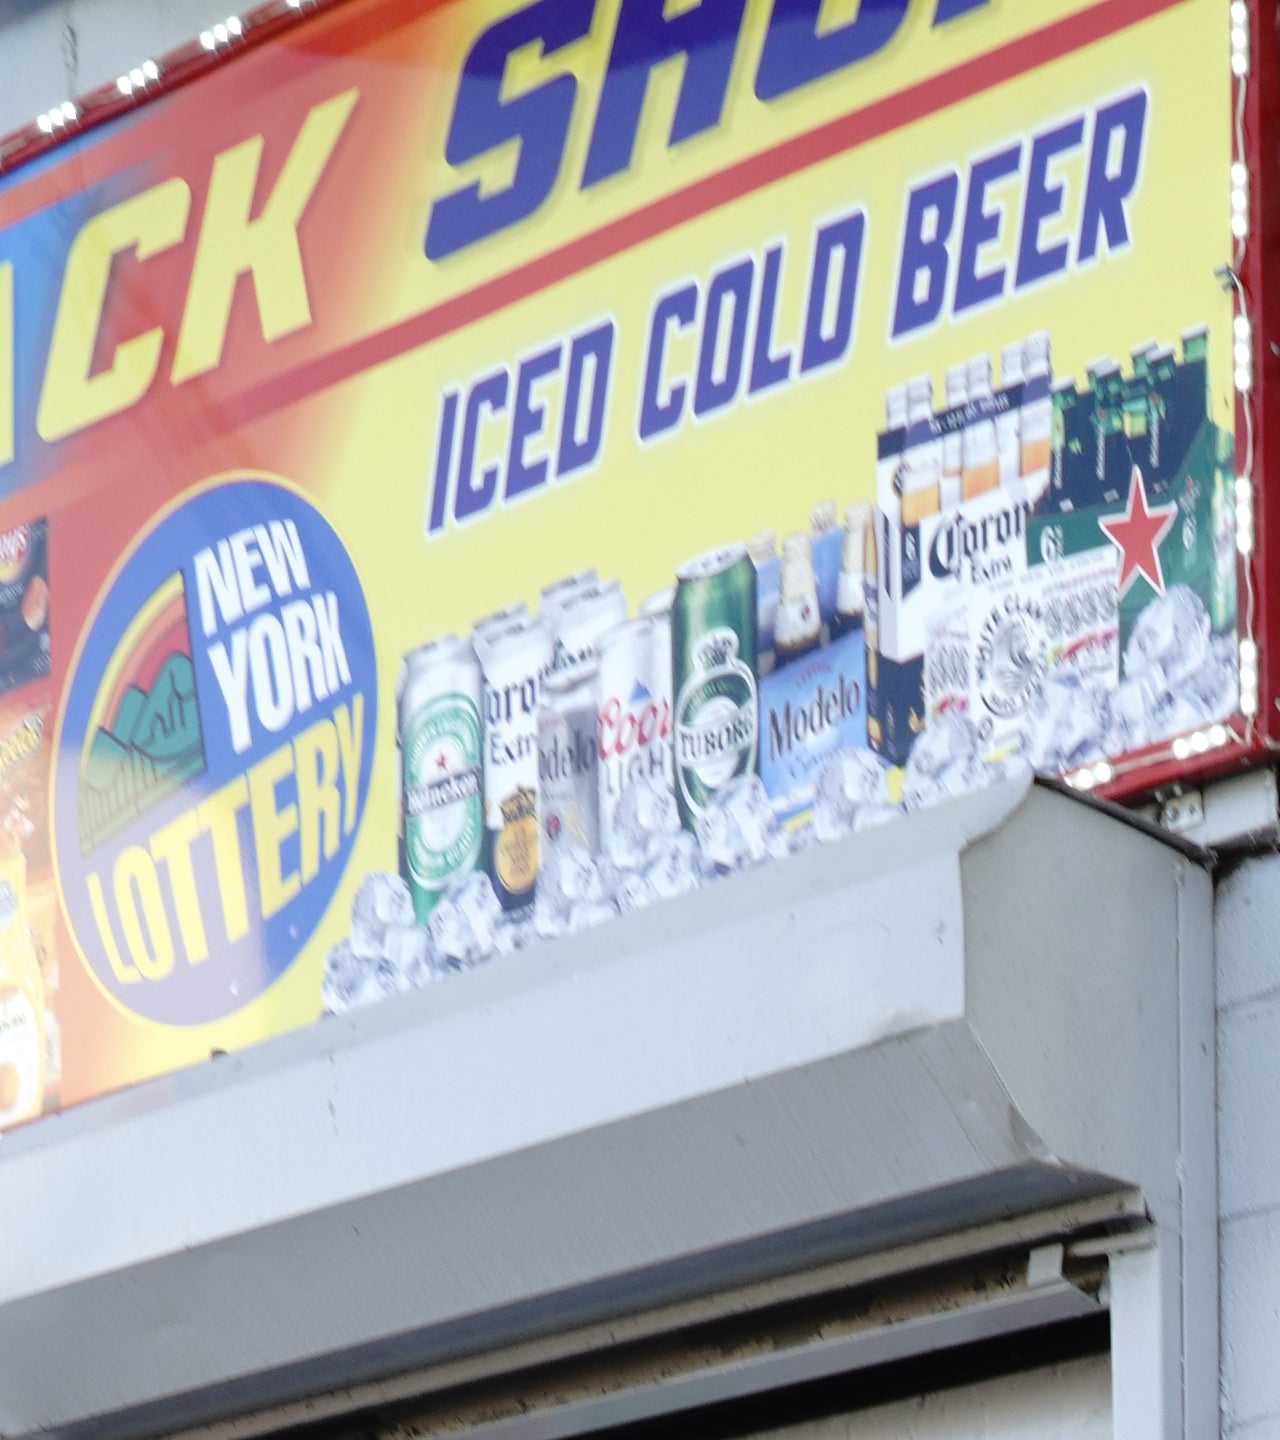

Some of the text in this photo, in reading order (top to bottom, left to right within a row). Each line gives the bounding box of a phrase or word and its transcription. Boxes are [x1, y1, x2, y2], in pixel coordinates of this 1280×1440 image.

[0, 86, 360, 470] CK
[427, 86, 1148, 537] ICED COLD BEER
[194, 518, 310, 637] NEW
[207, 591, 352, 753] YORK
[767, 680, 864, 762] Modelo
[86, 693, 365, 984] LOTTERY
